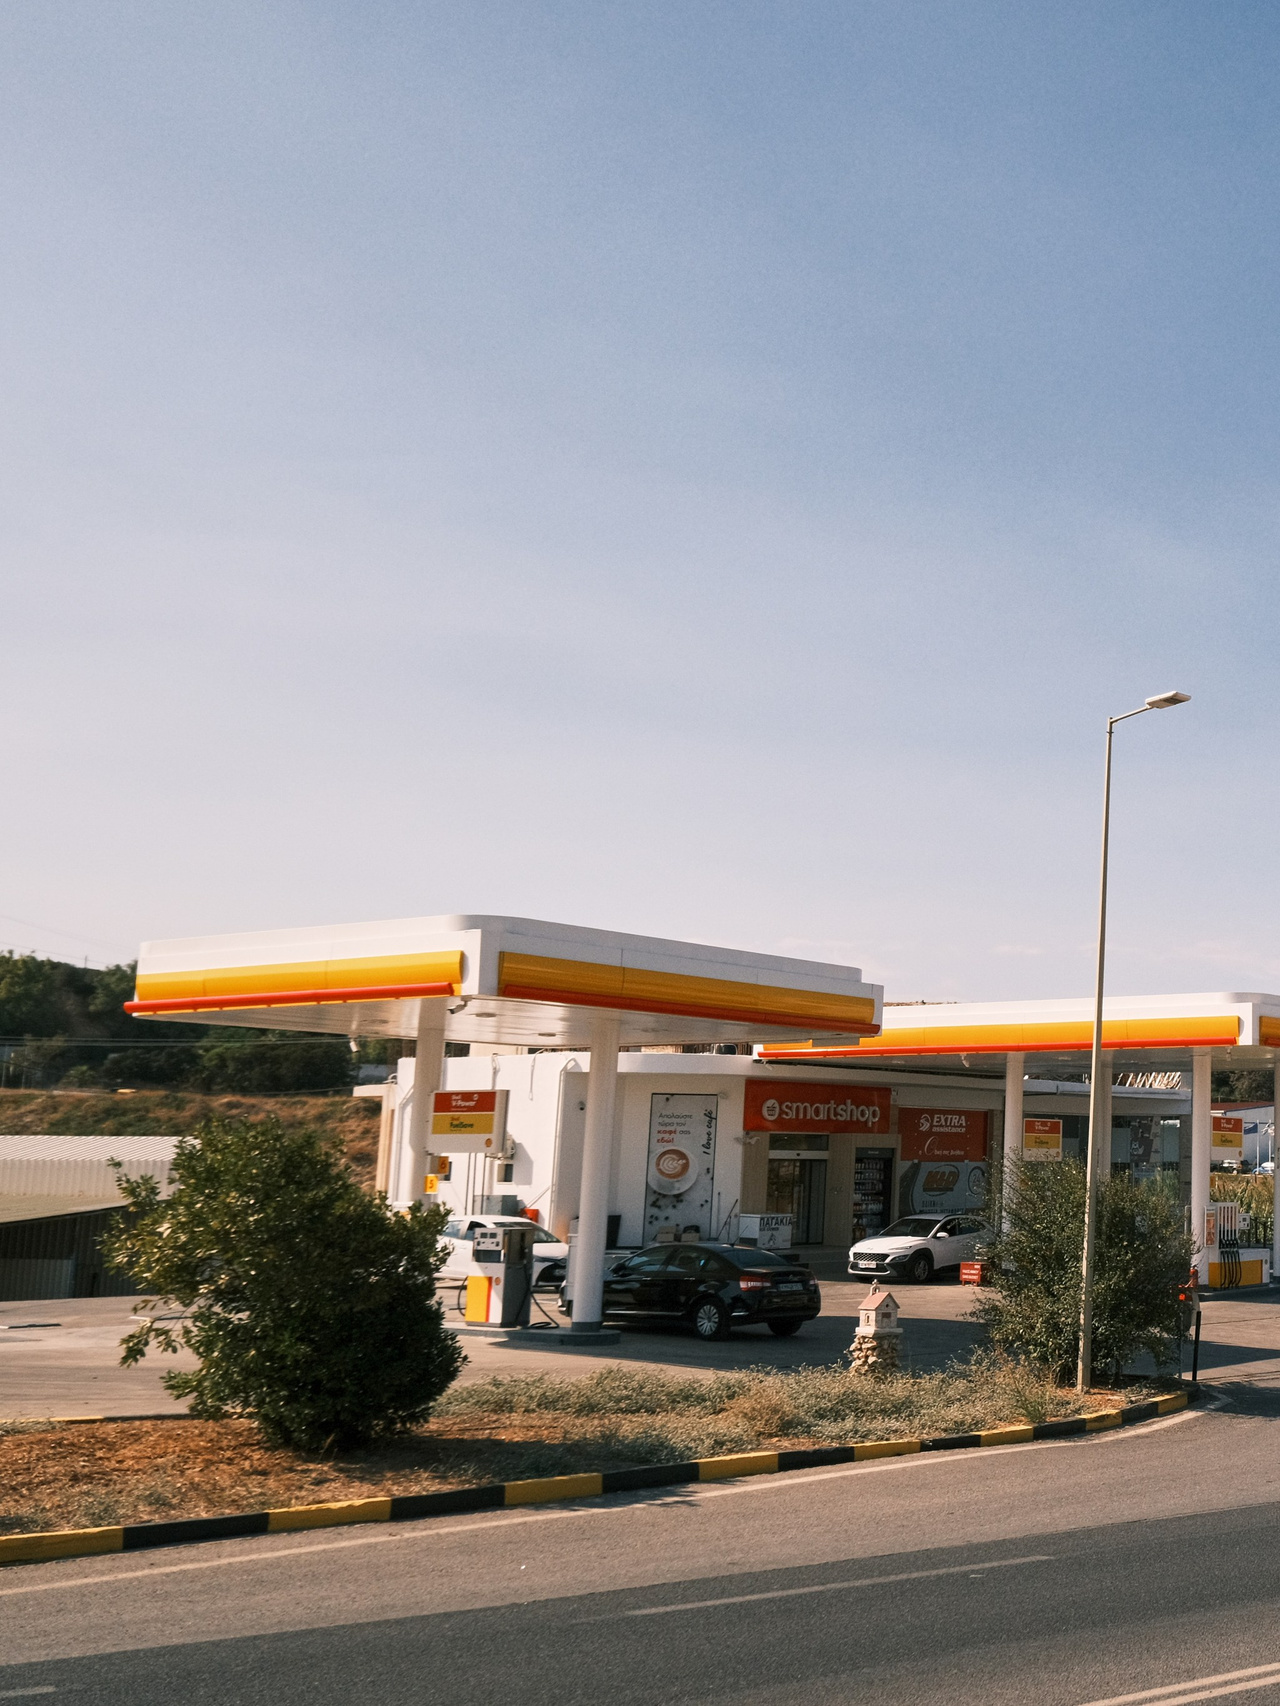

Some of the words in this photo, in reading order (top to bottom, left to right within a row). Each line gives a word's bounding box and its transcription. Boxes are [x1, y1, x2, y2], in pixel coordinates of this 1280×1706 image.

[781, 1099, 880, 1128] smartshop
[932, 1114, 966, 1127] EXTRA
[657, 1128, 677, 1136] καφέ
[702, 1130, 712, 1150] love
[428, 1179, 434, 1189] 5
[760, 1216, 793, 1228] ΠΑΓΑΚΙΑ
